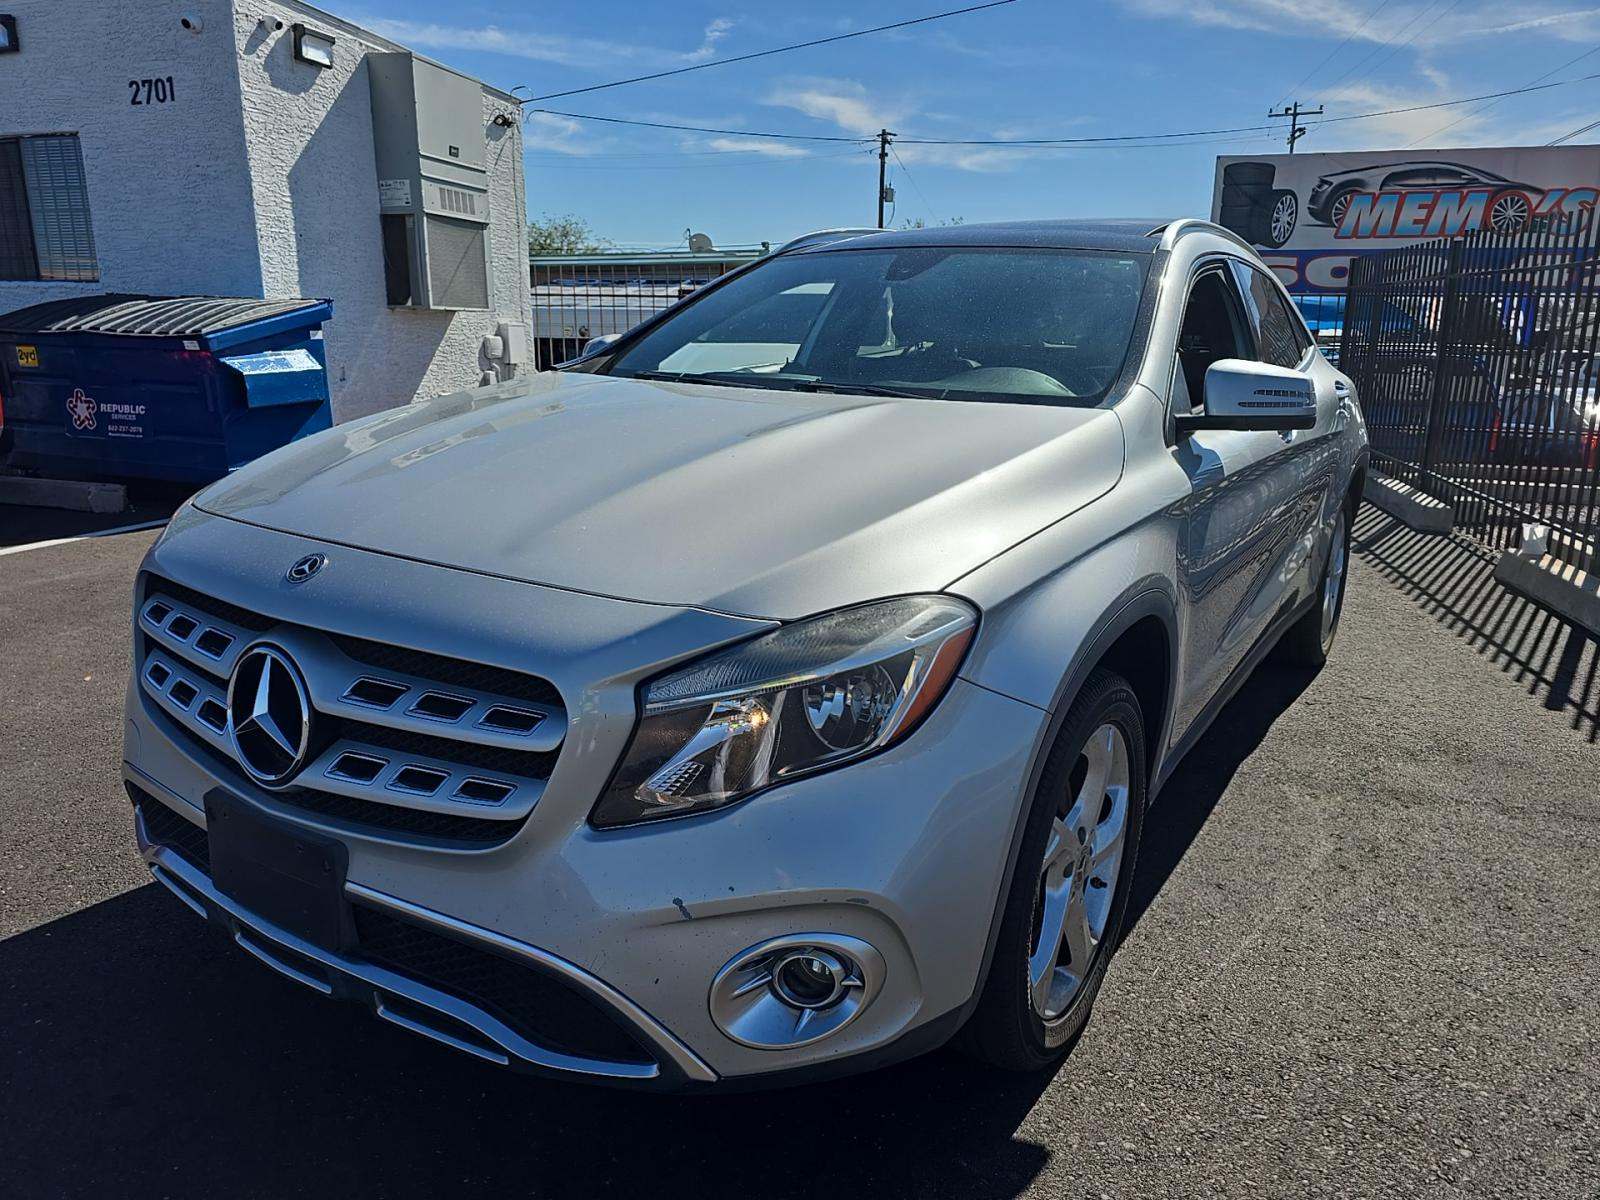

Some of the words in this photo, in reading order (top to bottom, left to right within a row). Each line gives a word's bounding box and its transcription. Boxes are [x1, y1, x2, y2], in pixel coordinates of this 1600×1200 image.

[128, 76, 175, 105] 2701
[18, 348, 36, 364] 2yd
[100, 403, 146, 414] REPUBLIC
